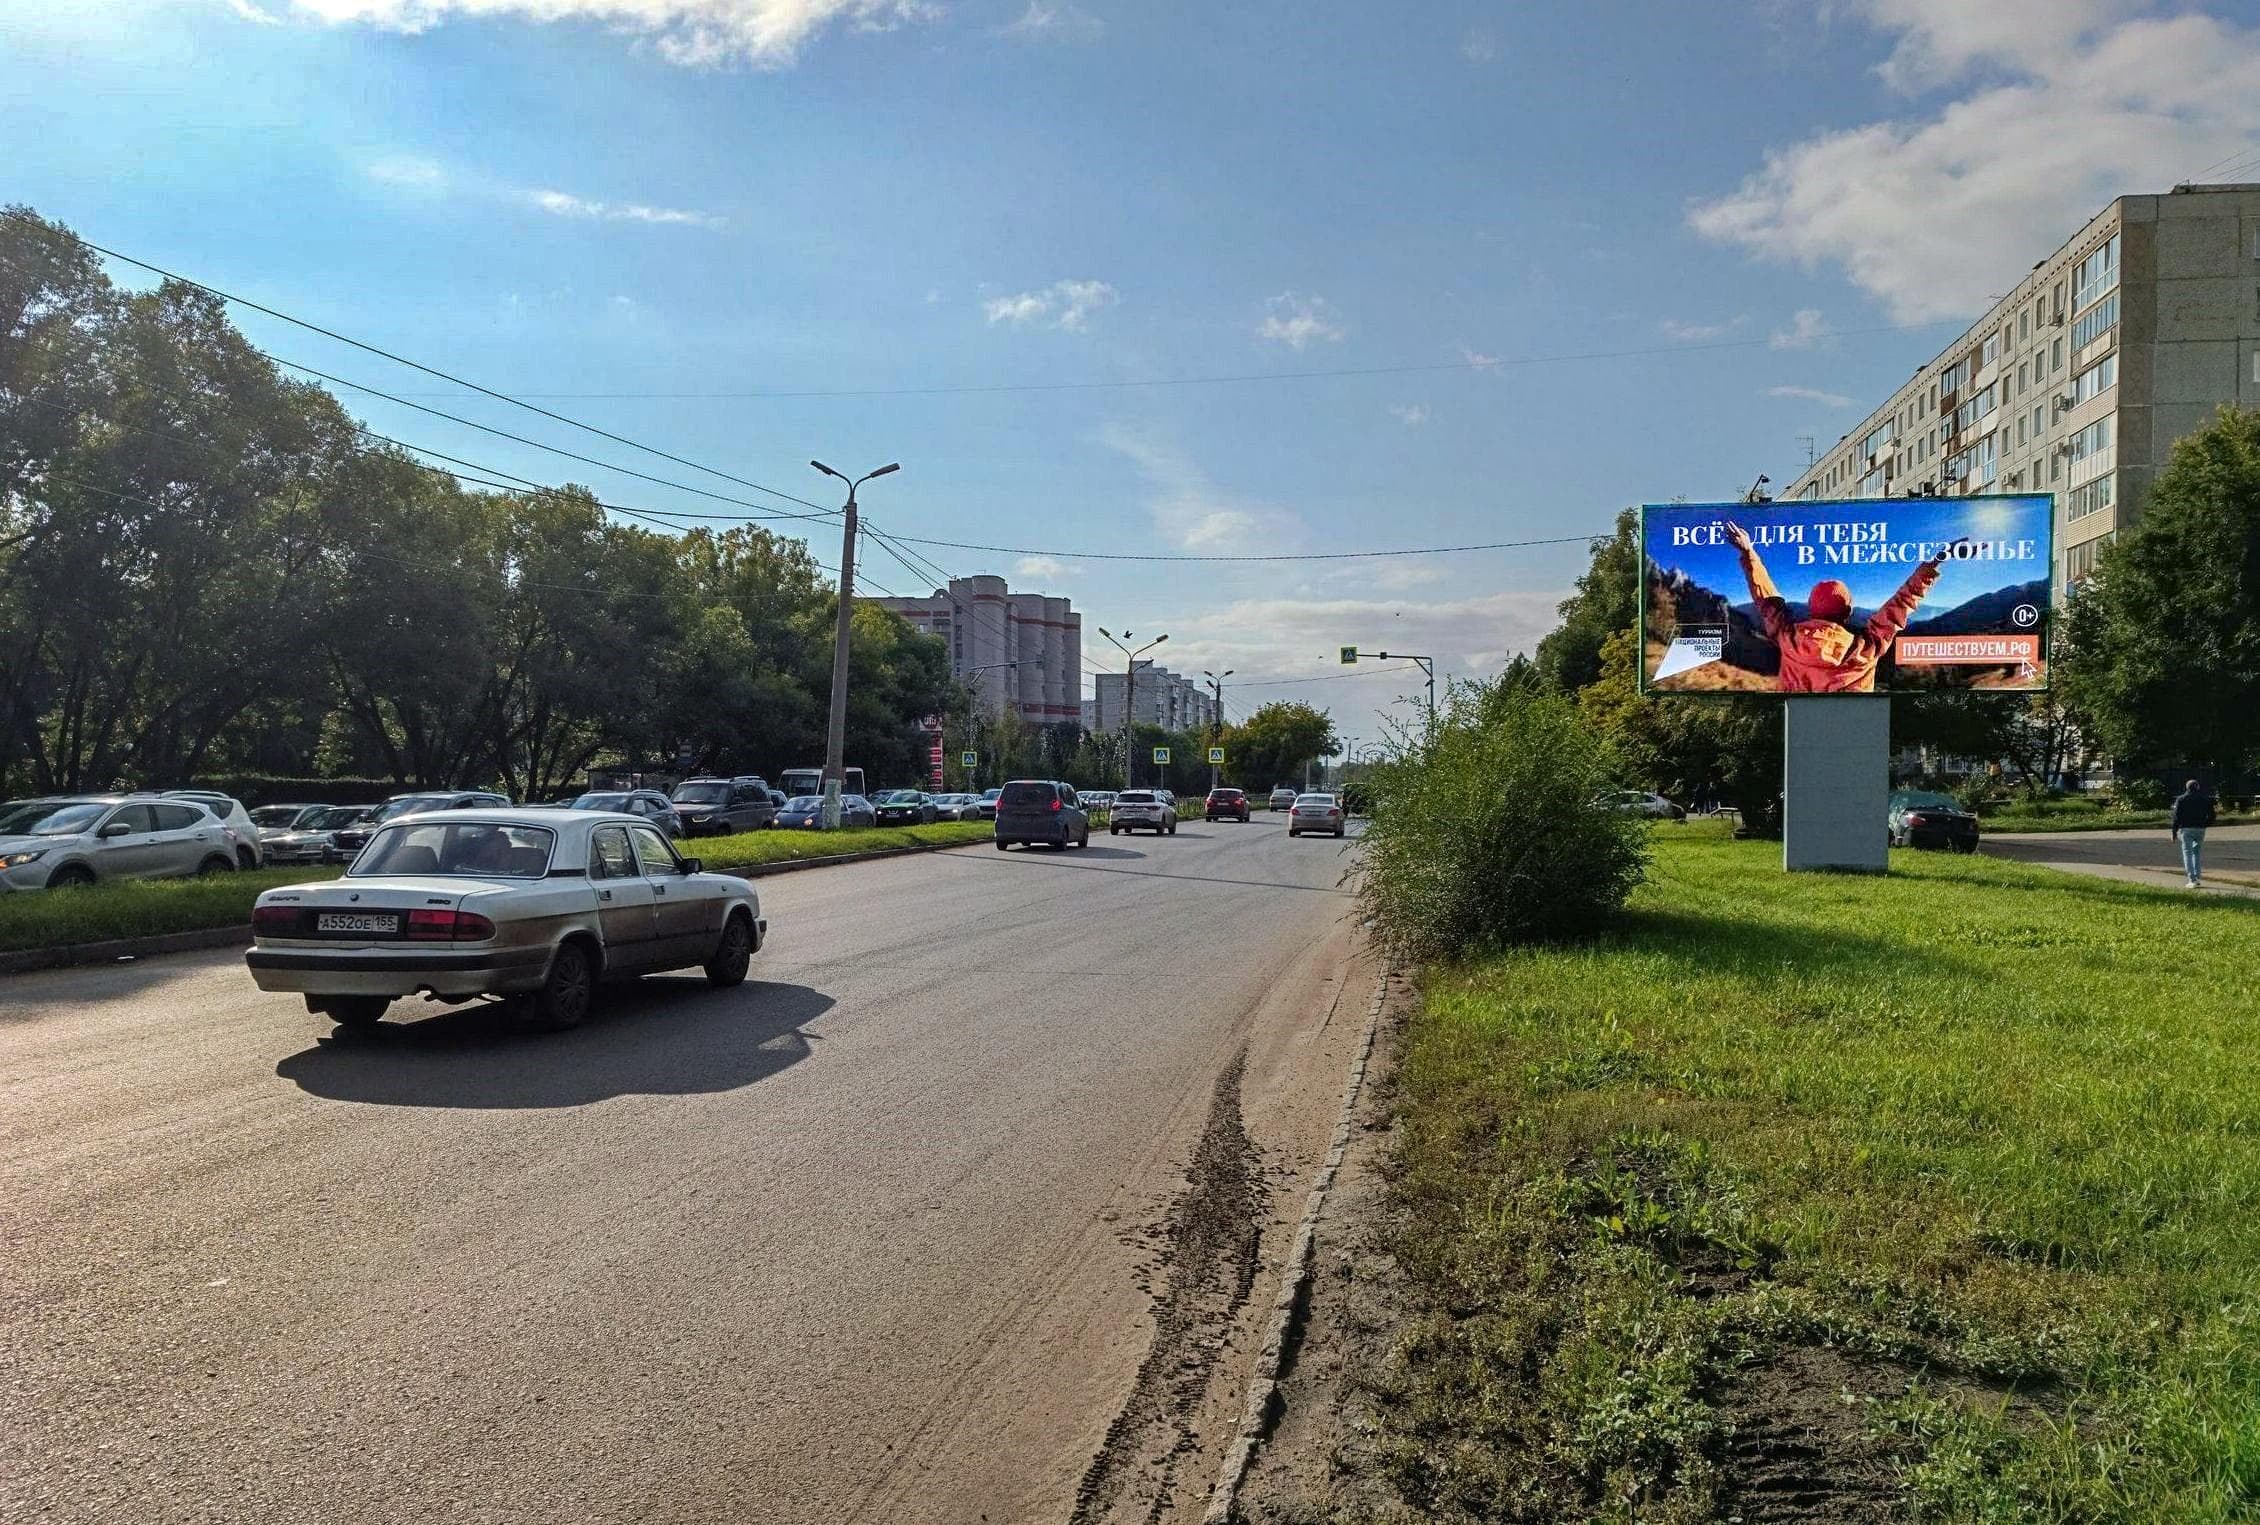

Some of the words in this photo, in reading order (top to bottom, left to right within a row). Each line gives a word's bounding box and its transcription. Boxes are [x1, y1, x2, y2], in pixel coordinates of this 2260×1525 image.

[1672, 521, 1725, 546] ВСЁ
[1752, 525, 1804, 546] ДЛЯ
[1814, 521, 1888, 543] ТЕБЯ
[1797, 544, 1816, 565] В
[1824, 539, 2036, 564] МЕЖСЕЗОНЬЕ
[1902, 641, 2031, 658] ПУТЕШЕСТВУЕМ.РФ
